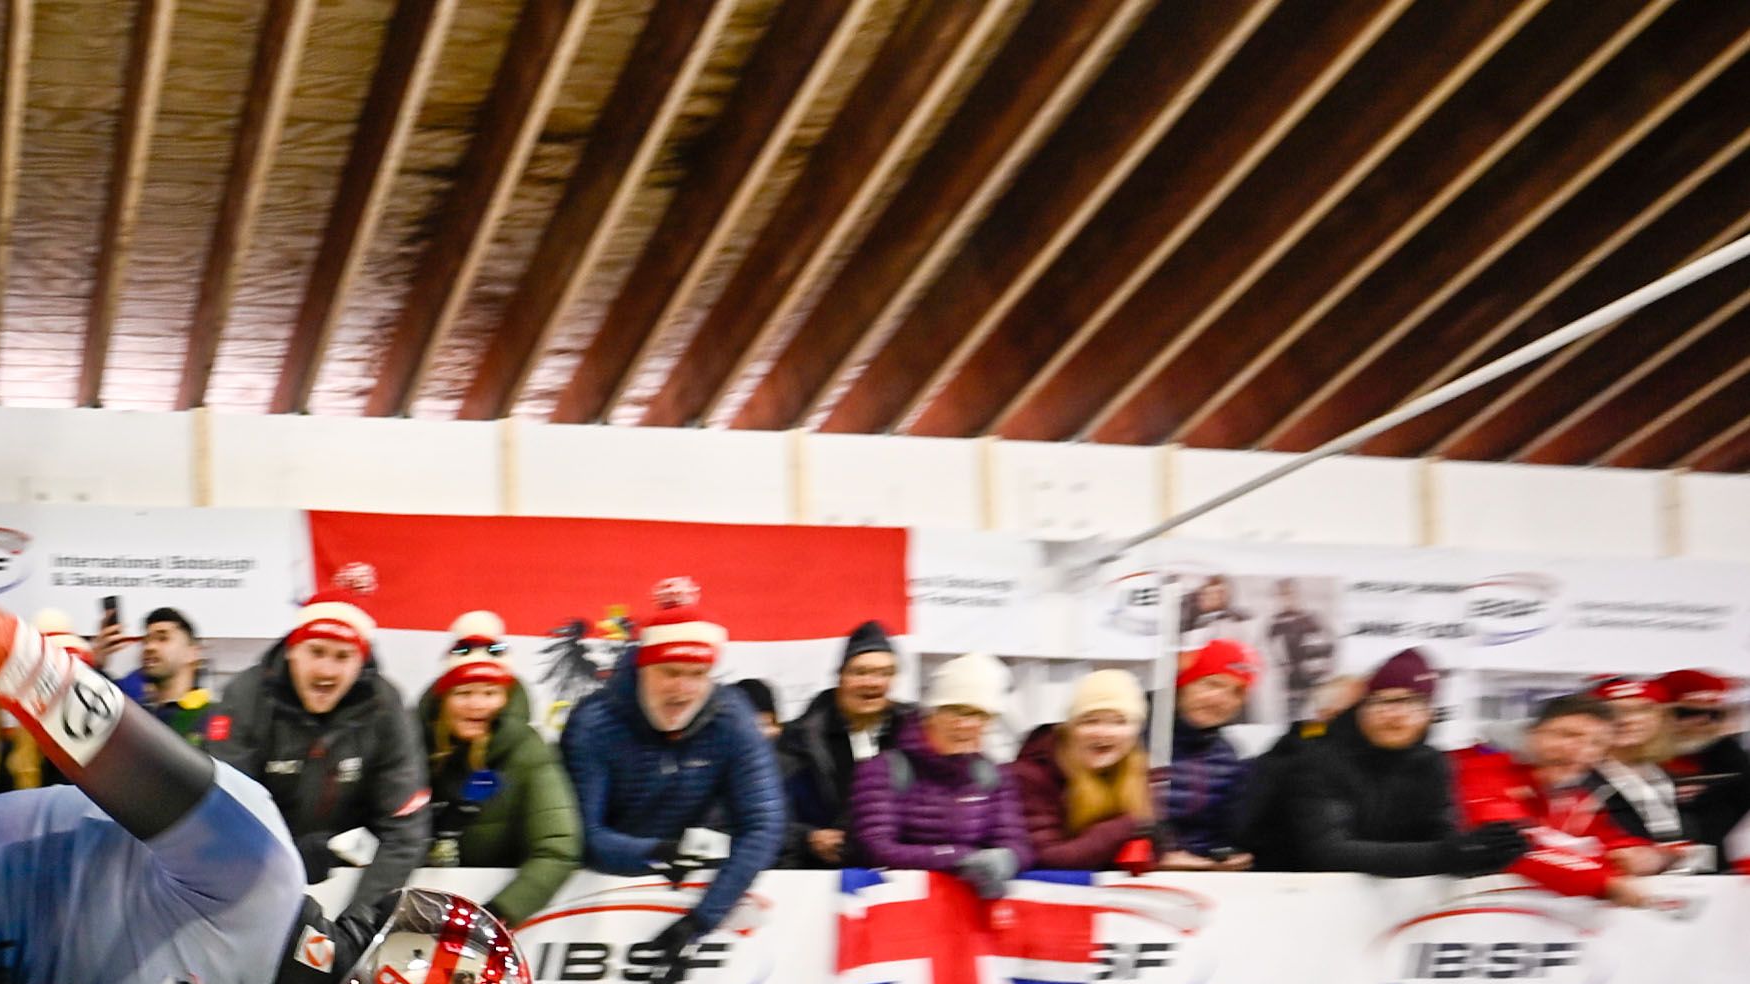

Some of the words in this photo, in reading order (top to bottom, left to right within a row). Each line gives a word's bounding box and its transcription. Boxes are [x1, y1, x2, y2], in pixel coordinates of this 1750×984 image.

[53, 553, 161, 569] International
[535, 942, 732, 981] IBSF
[1092, 943, 1181, 980] SF
[1403, 942, 1586, 979] IBSF
